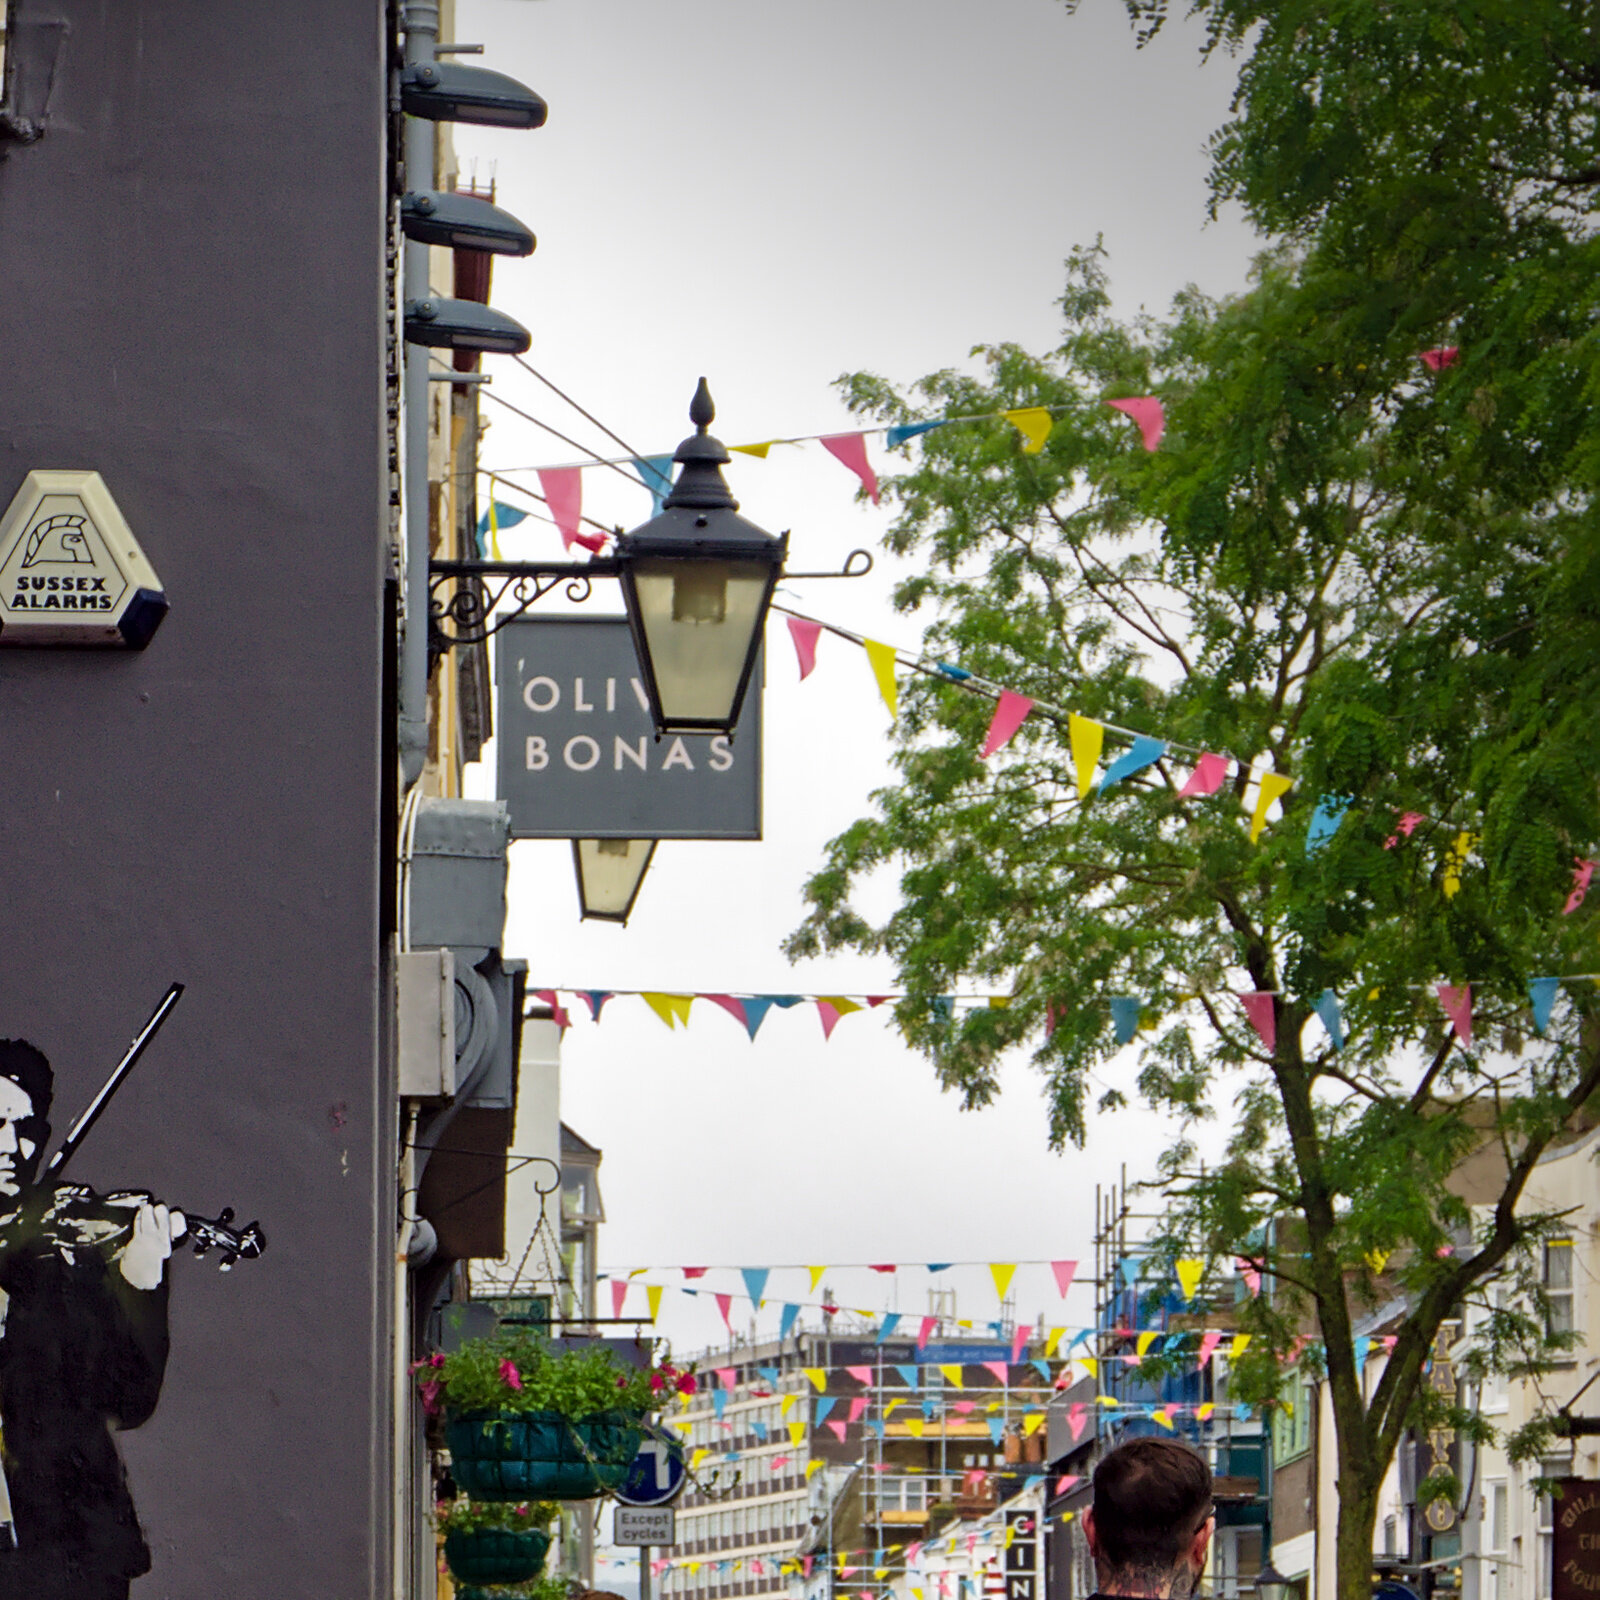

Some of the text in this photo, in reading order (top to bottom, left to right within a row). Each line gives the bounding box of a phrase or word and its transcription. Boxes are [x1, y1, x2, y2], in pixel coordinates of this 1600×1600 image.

[16, 576, 106, 592] SUSSEX
[11, 593, 112, 609] ALARMS
[523, 676, 650, 712] OLIV
[525, 734, 735, 772] BONAS
[621, 1512, 670, 1526] Except
[623, 1528, 667, 1541] cycles
